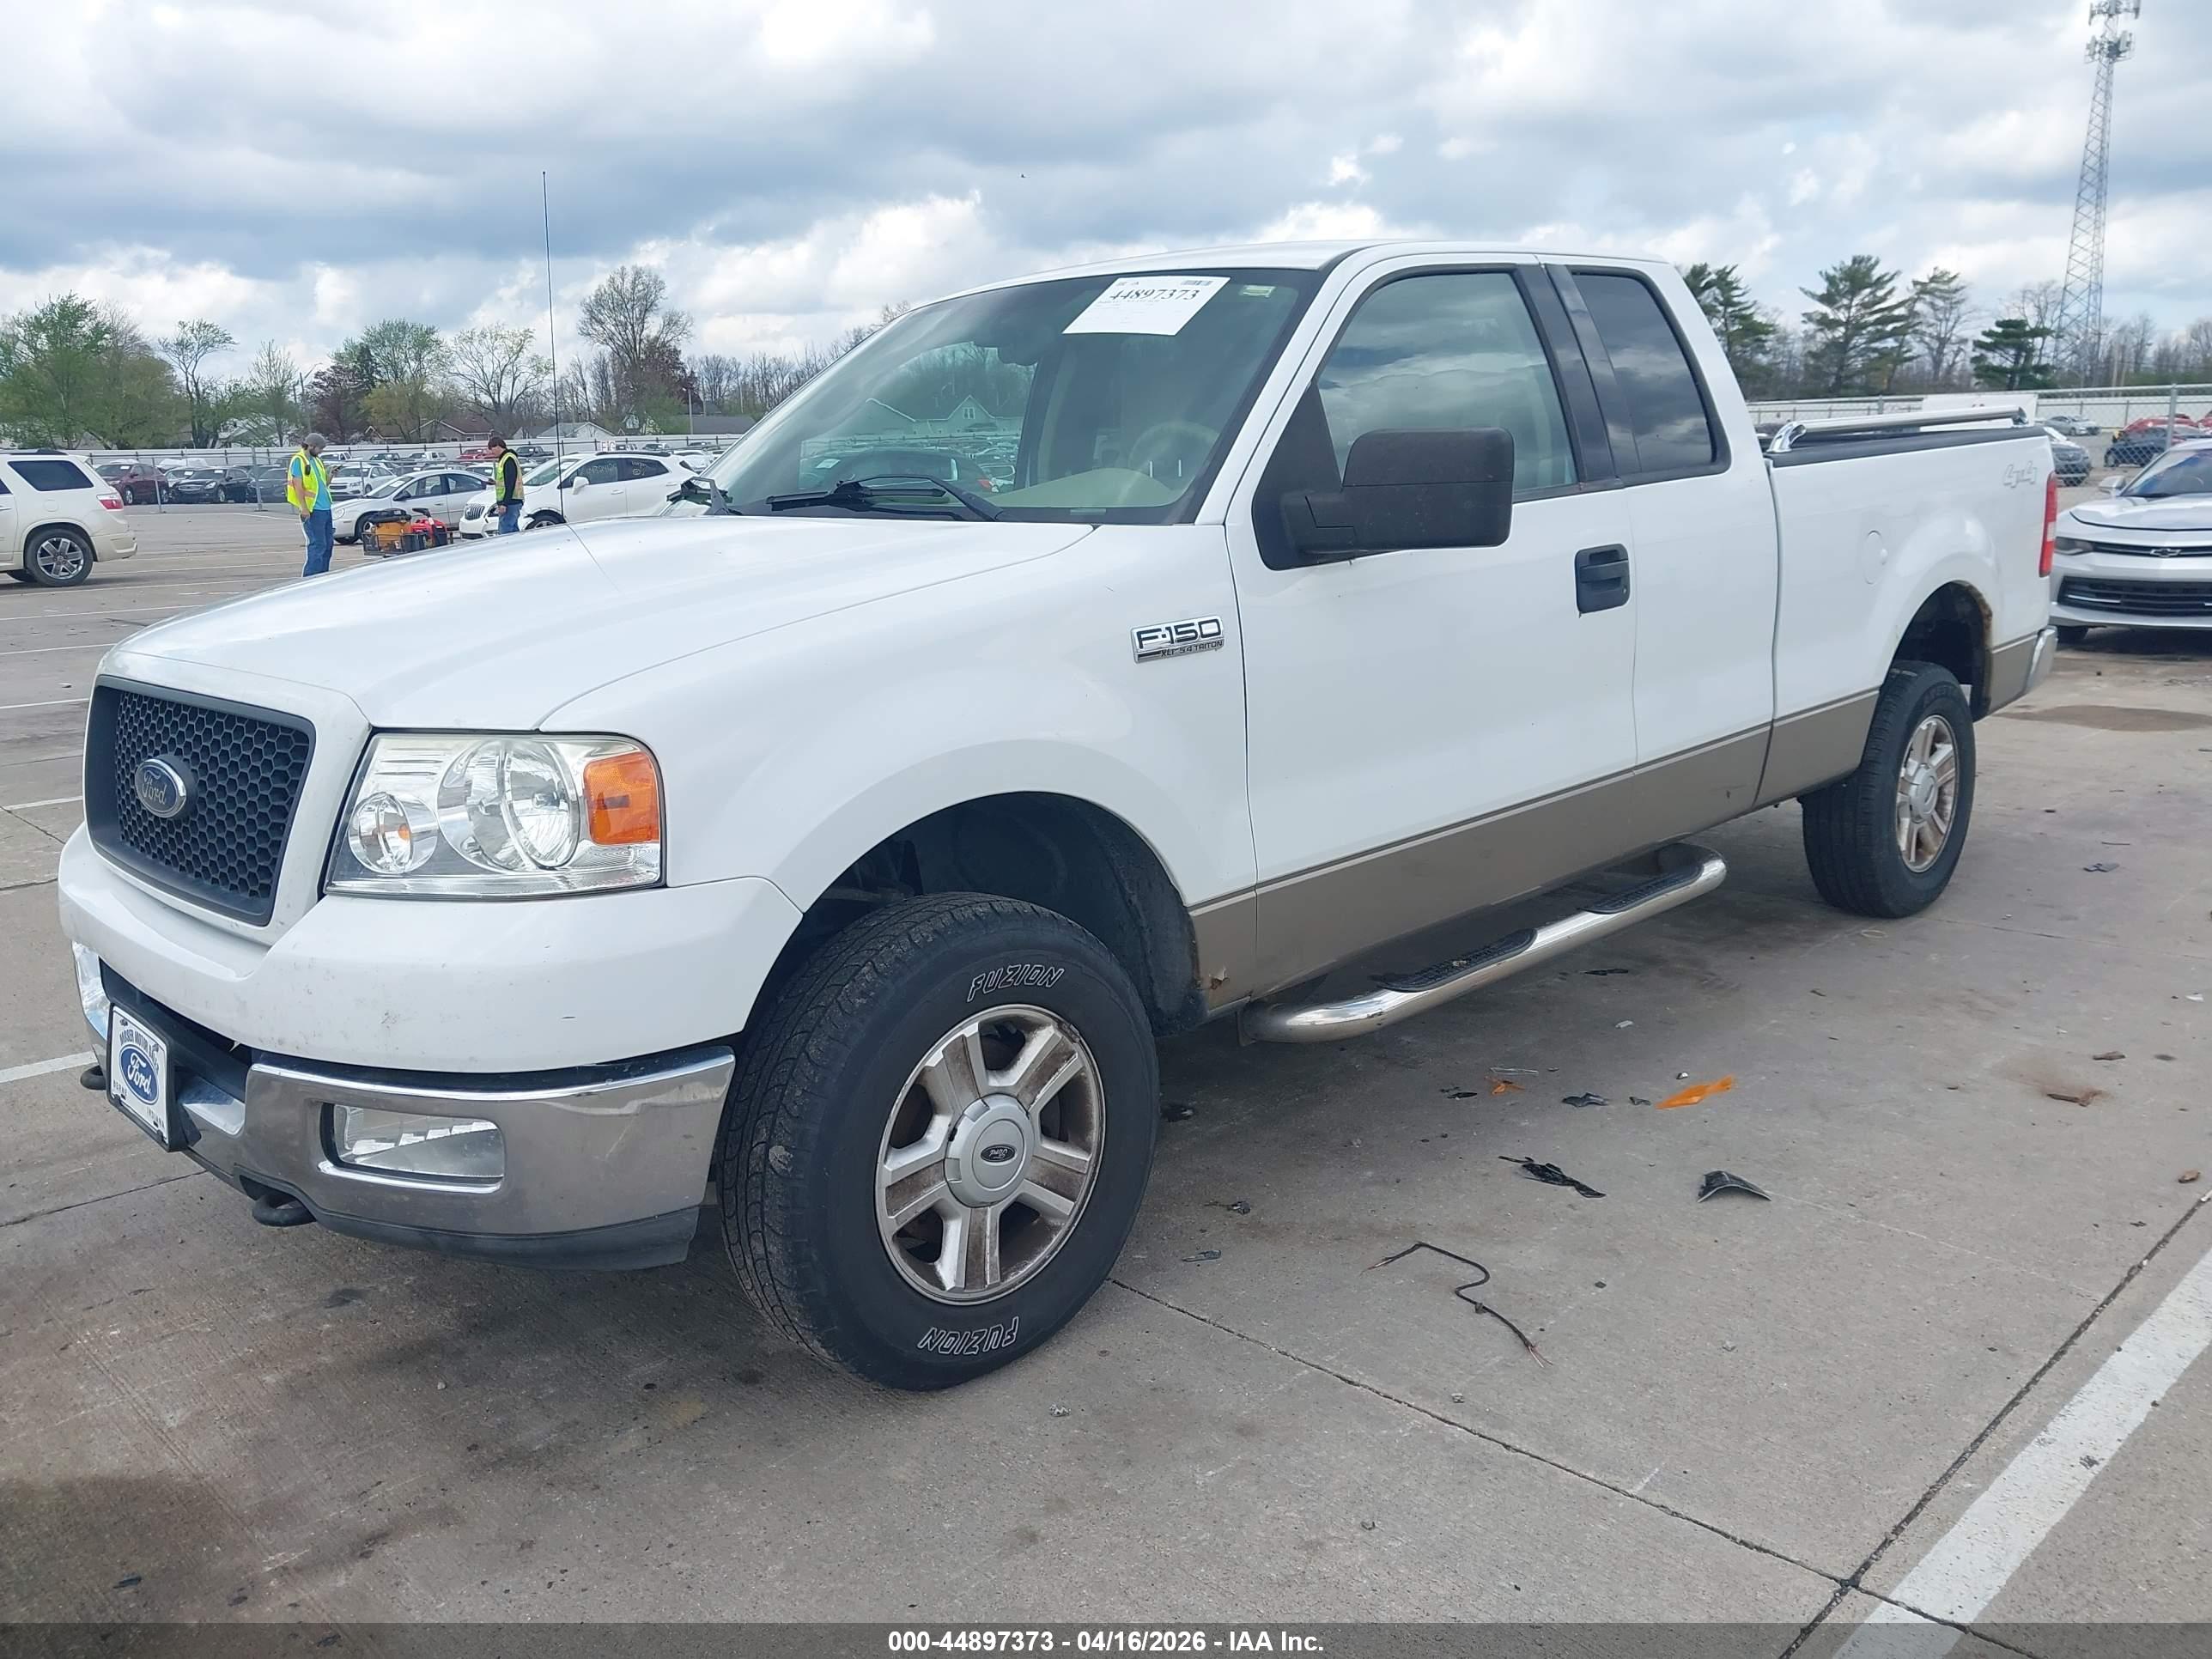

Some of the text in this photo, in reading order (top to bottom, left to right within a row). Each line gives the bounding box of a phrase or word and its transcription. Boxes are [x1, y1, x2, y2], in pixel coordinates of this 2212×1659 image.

[1109, 289, 1200, 301] 44897373
[1194, 640, 1223, 651] TRITON
[142, 769, 167, 805] Ford
[966, 963, 1065, 1003] FUZION
[127, 1052, 152, 1096] Ford
[917, 1316, 1019, 1355] FUZION
